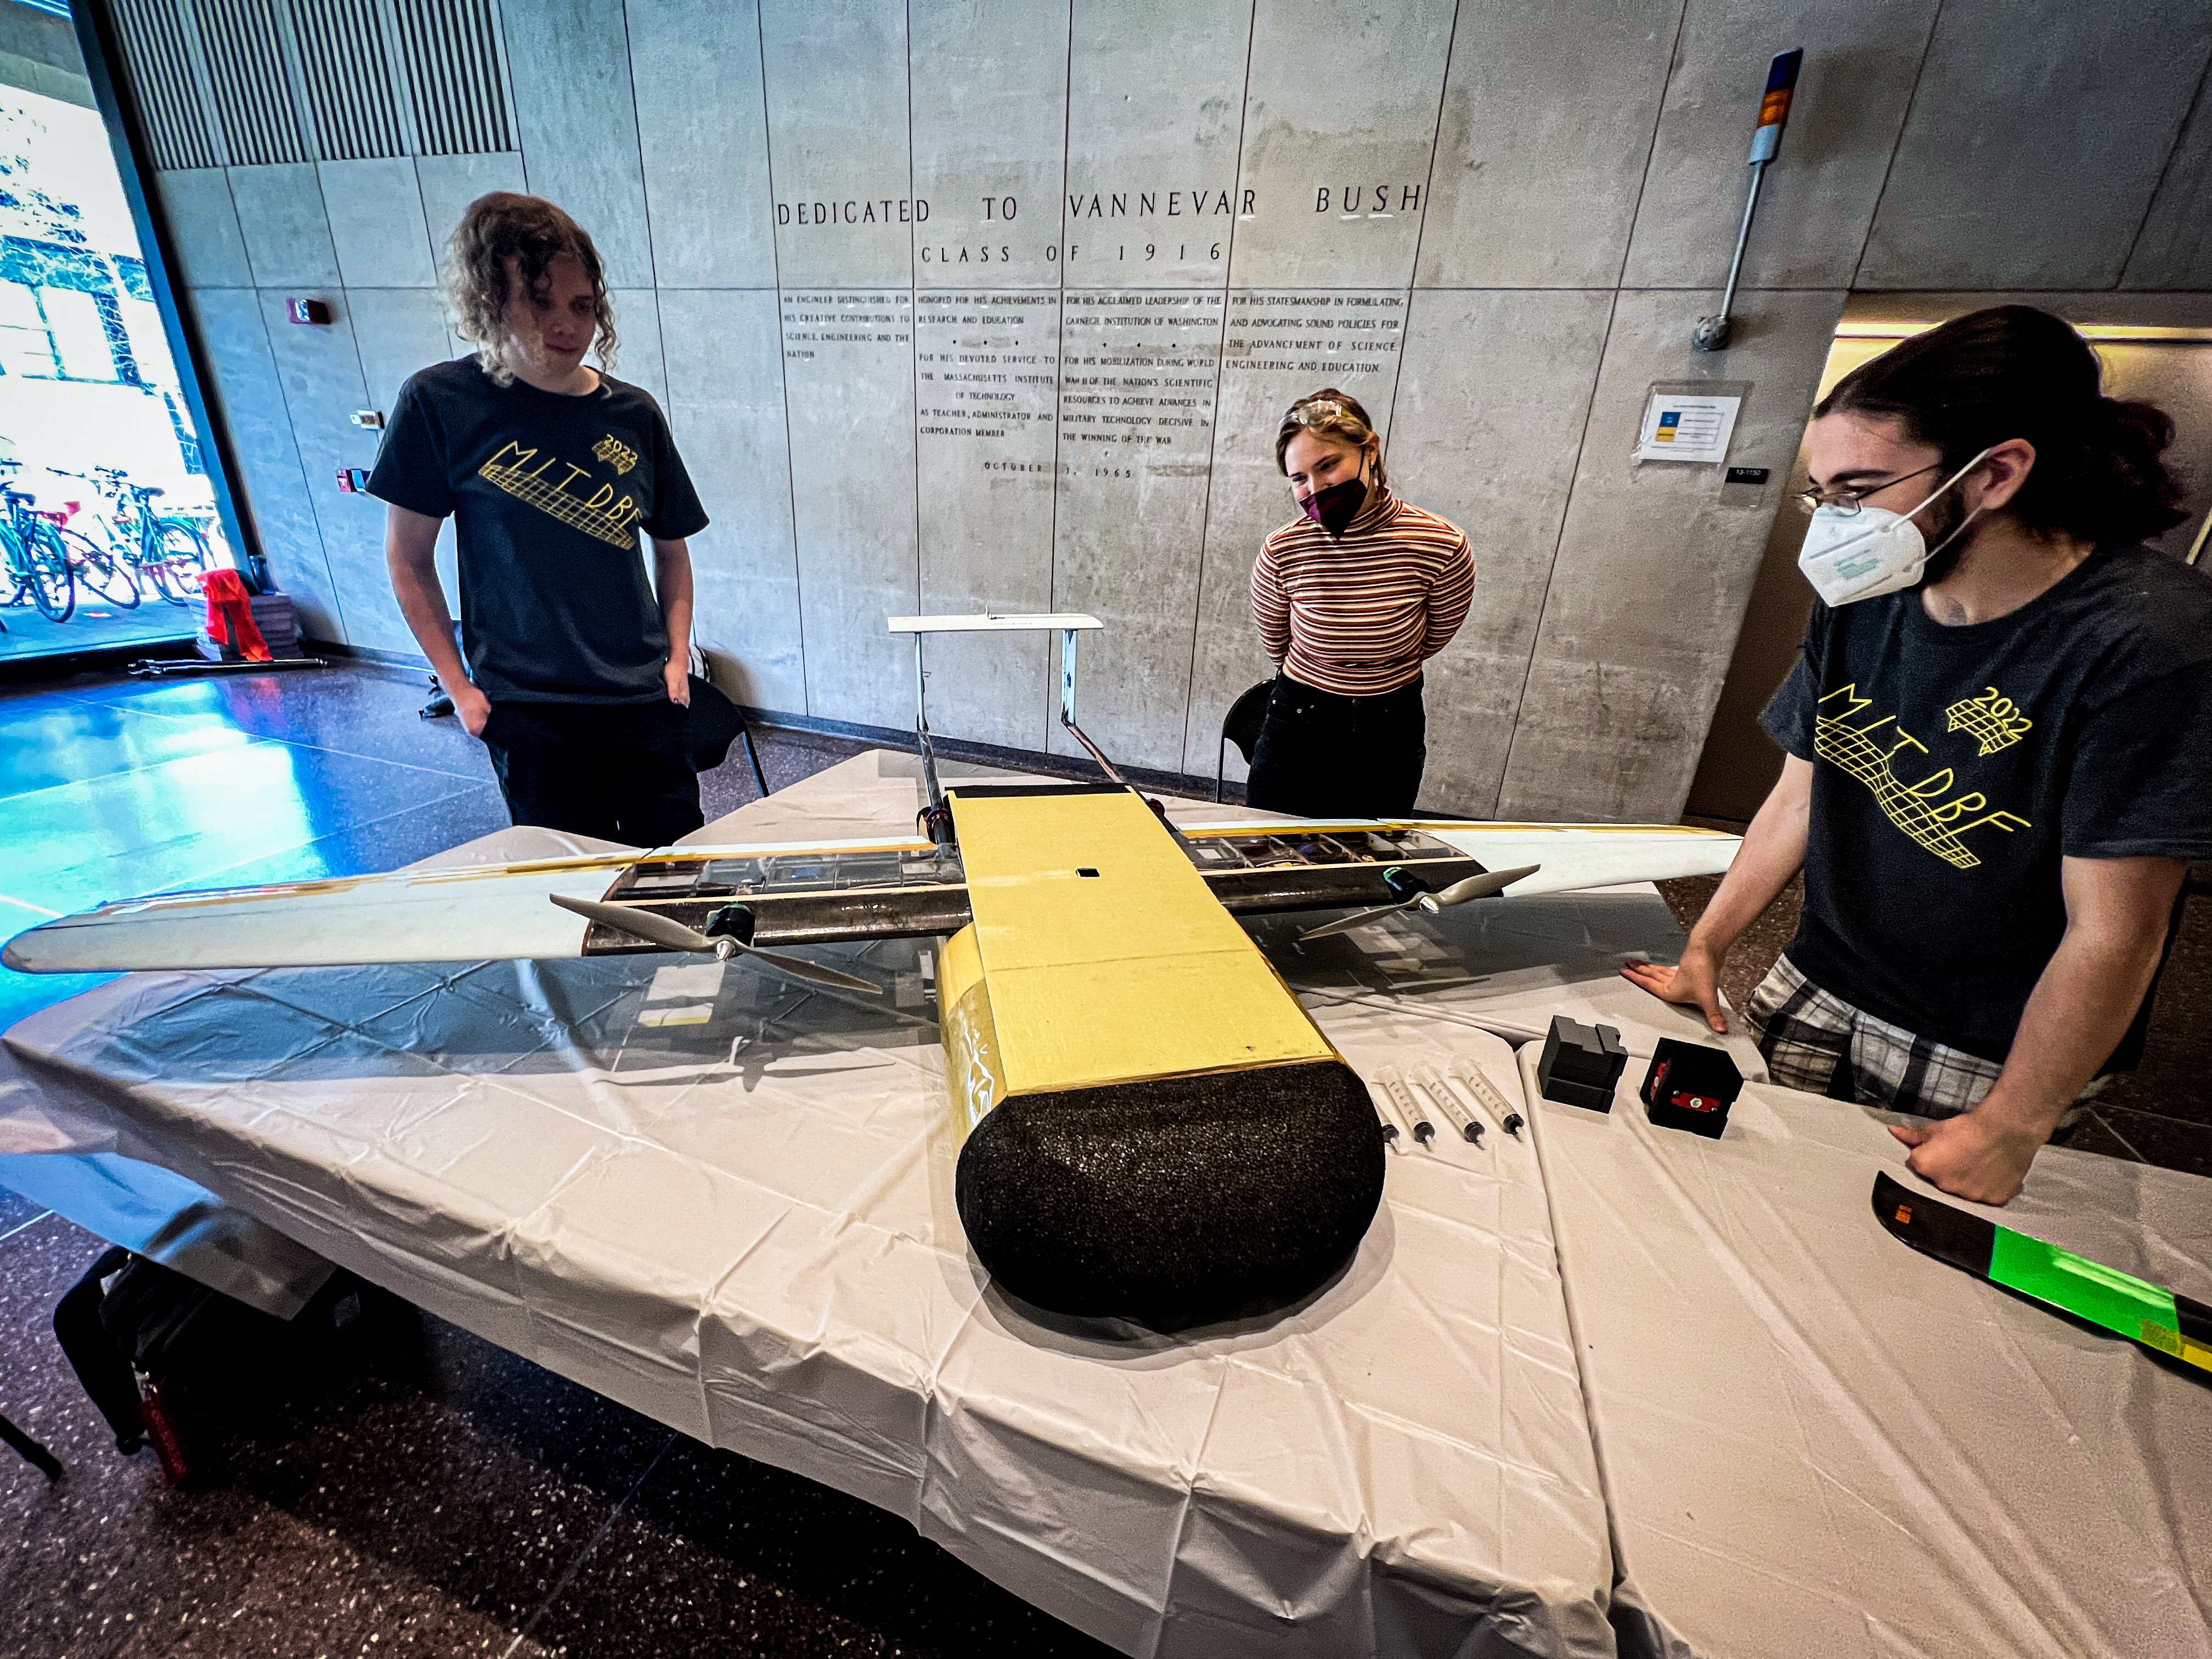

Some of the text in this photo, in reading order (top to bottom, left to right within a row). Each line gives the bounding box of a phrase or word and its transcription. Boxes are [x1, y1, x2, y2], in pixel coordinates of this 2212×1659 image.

[777, 184, 1420, 225] DEDICATED TO VANNEVAR BUSH
[921, 242, 1220, 263] CLASS OF 1916
[837, 296, 890, 304] DISTINGUISHED
[991, 296, 1045, 304] ACHIEVEMENTS
[1066, 297, 1080, 305] FOR
[1098, 297, 1142, 305] ACCLAIMED
[1232, 297, 1246, 306] FOR
[1250, 297, 1263, 306] HIS
[1267, 297, 1330, 306] STATESMANSHIP
[1347, 298, 1403, 307] FORMULATING
[841, 314, 895, 323] CONTRIBUTIONS
[1066, 317, 1100, 325] CARNEGIE
[1251, 319, 1302, 328] ADVOCATING
[1306, 319, 1334, 328] SOUND
[1338, 319, 1376, 329] POLICIES
[1381, 320, 1398, 329] FOR
[1229, 340, 1244, 348] THE
[1250, 340, 1321, 349] ADVANCEMENT
[1328, 341, 1342, 350] OF
[1003, 356, 1036, 364] SERVICE
[1226, 360, 1293, 370] ENGINEERING
[1298, 362, 1316, 370] AND
[944, 374, 1007, 382] MASSACHUSETTS
[1015, 375, 1053, 384] INSTITUTE
[1164, 379, 1212, 387] SCIENTIFIC
[1122, 397, 1153, 405] ACHIEVE
[1159, 398, 1196, 407] ADVANCES
[972, 411, 1030, 420] ADMINISTRATOR
[1103, 416, 1151, 425] TECHNOLOGY
[921, 427, 971, 435] CORPORATION
[1156, 436, 1171, 444] WAR
[604, 433, 638, 461] 2022
[985, 462, 1042, 472] OCTOBER
[1096, 469, 1130, 478] 1965
[1973, 686, 2033, 741] 2022
[1909, 768, 2032, 834] DBF
